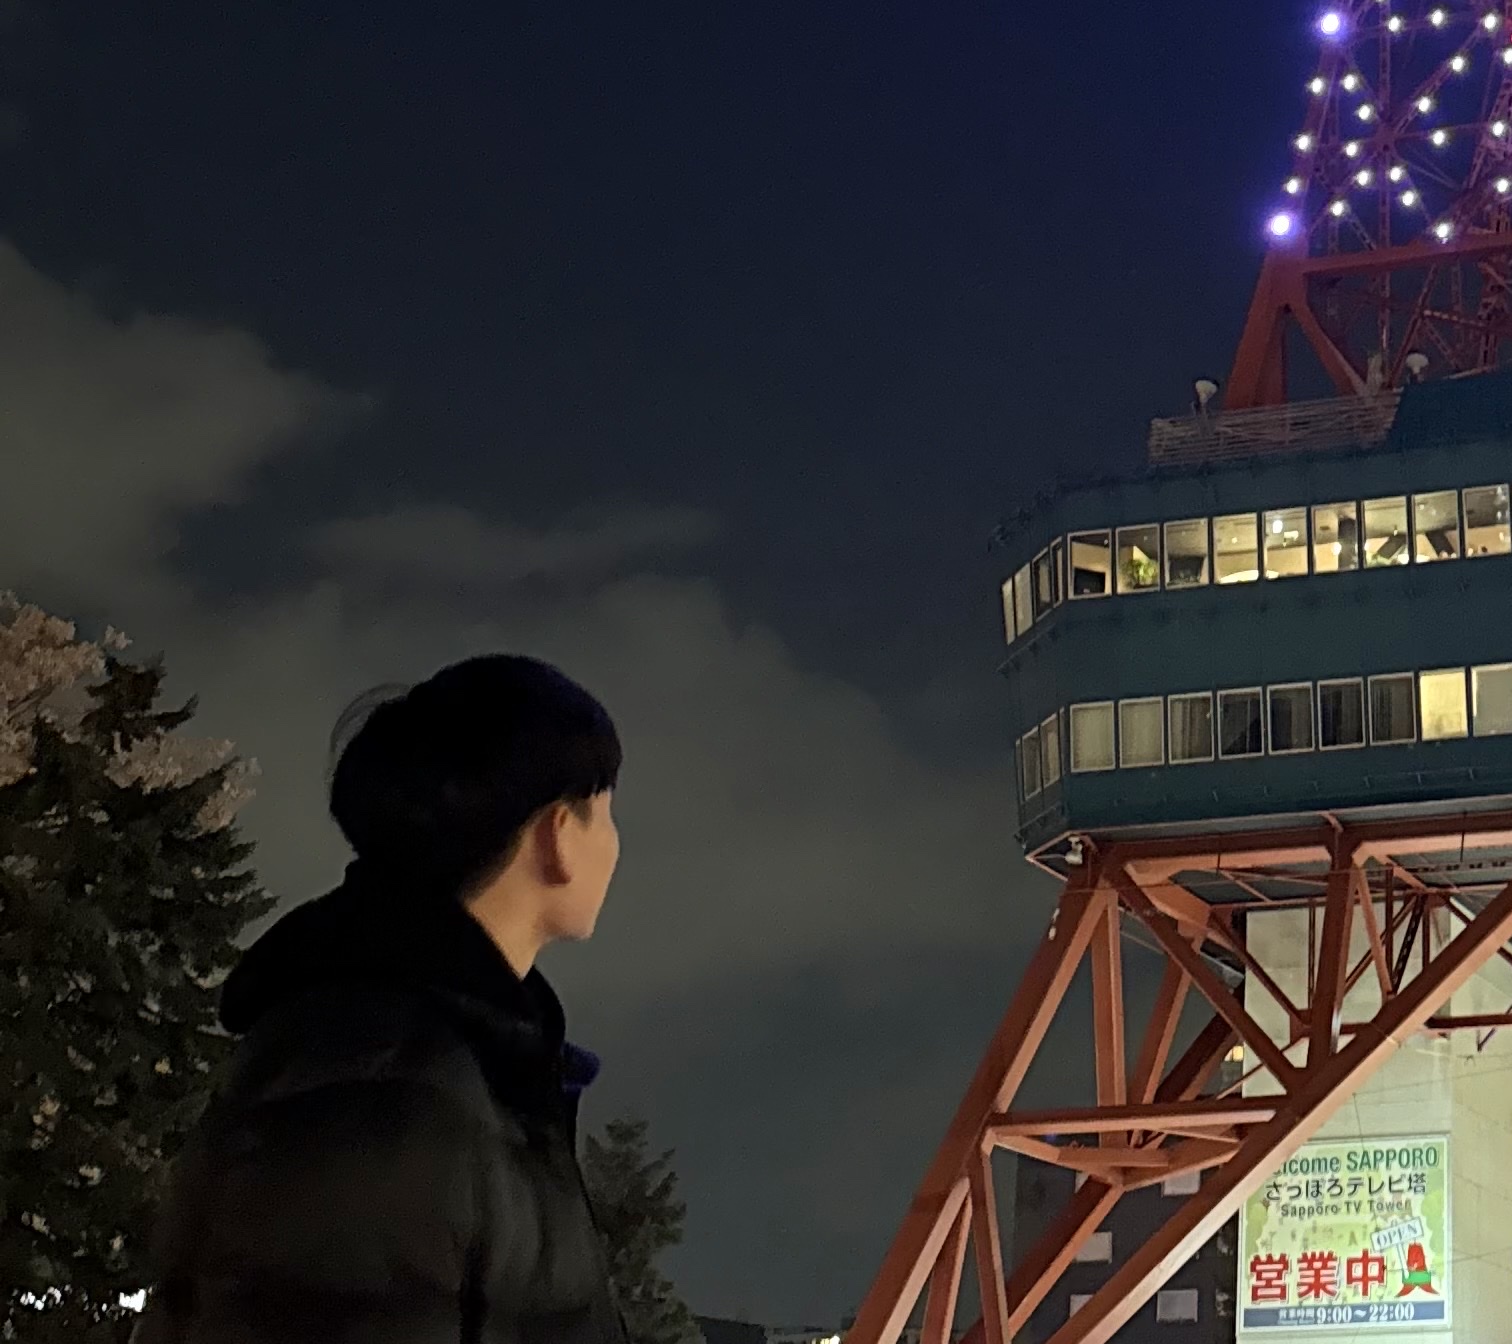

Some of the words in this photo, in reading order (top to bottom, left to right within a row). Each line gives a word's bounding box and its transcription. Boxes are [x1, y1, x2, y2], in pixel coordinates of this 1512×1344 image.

[1346, 1146, 1439, 1173] SAPPORO
[1265, 1172, 1427, 1201] さっぽろテレビ塔
[1280, 1203, 1341, 1220] Sapporo
[1344, 1201, 1362, 1215] TV
[1376, 1222, 1419, 1247] OPEN
[1250, 1248, 1386, 1302] 営業中
